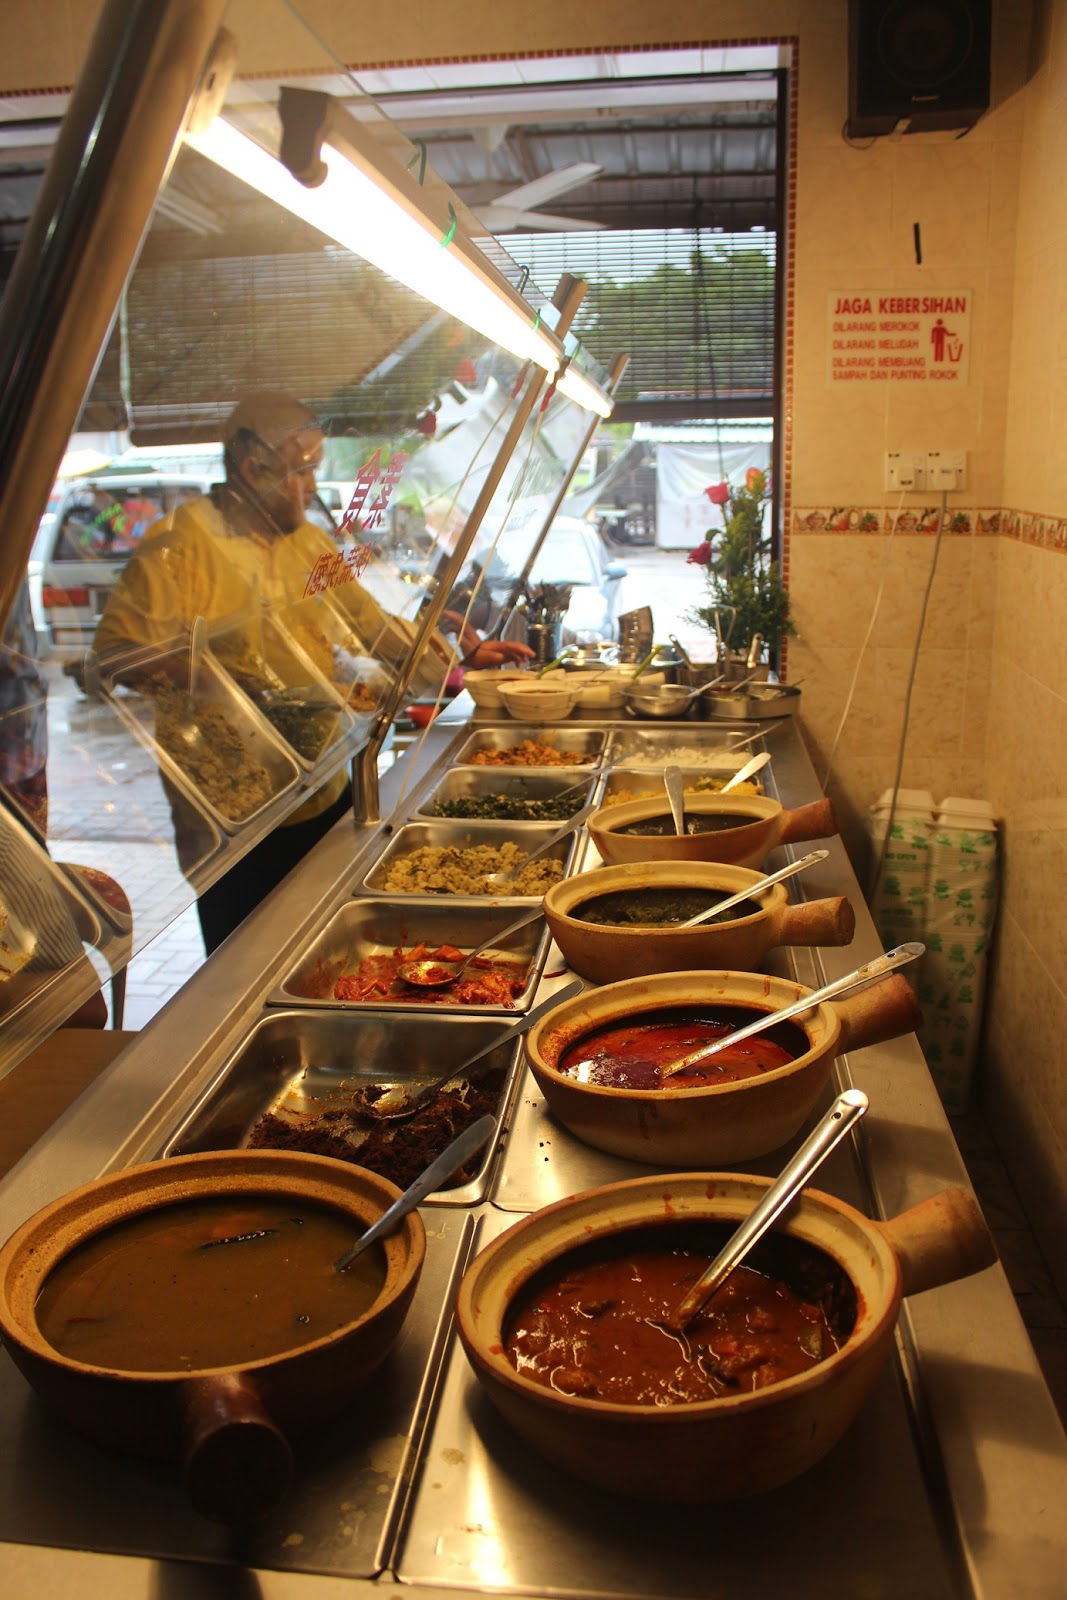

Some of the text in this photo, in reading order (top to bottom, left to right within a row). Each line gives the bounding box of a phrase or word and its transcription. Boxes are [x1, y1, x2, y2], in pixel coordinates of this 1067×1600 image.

[834, 297, 966, 314] JAGA KEBERSIHAN
[833, 322, 920, 331] DILARANG MEROKOK
[833, 339, 919, 349] DILARANG MELUDAH
[832, 357, 925, 367] DILARANG MEMBUANG
[833, 370, 958, 380] SAMPAH DAN PUNTING ROKOK
